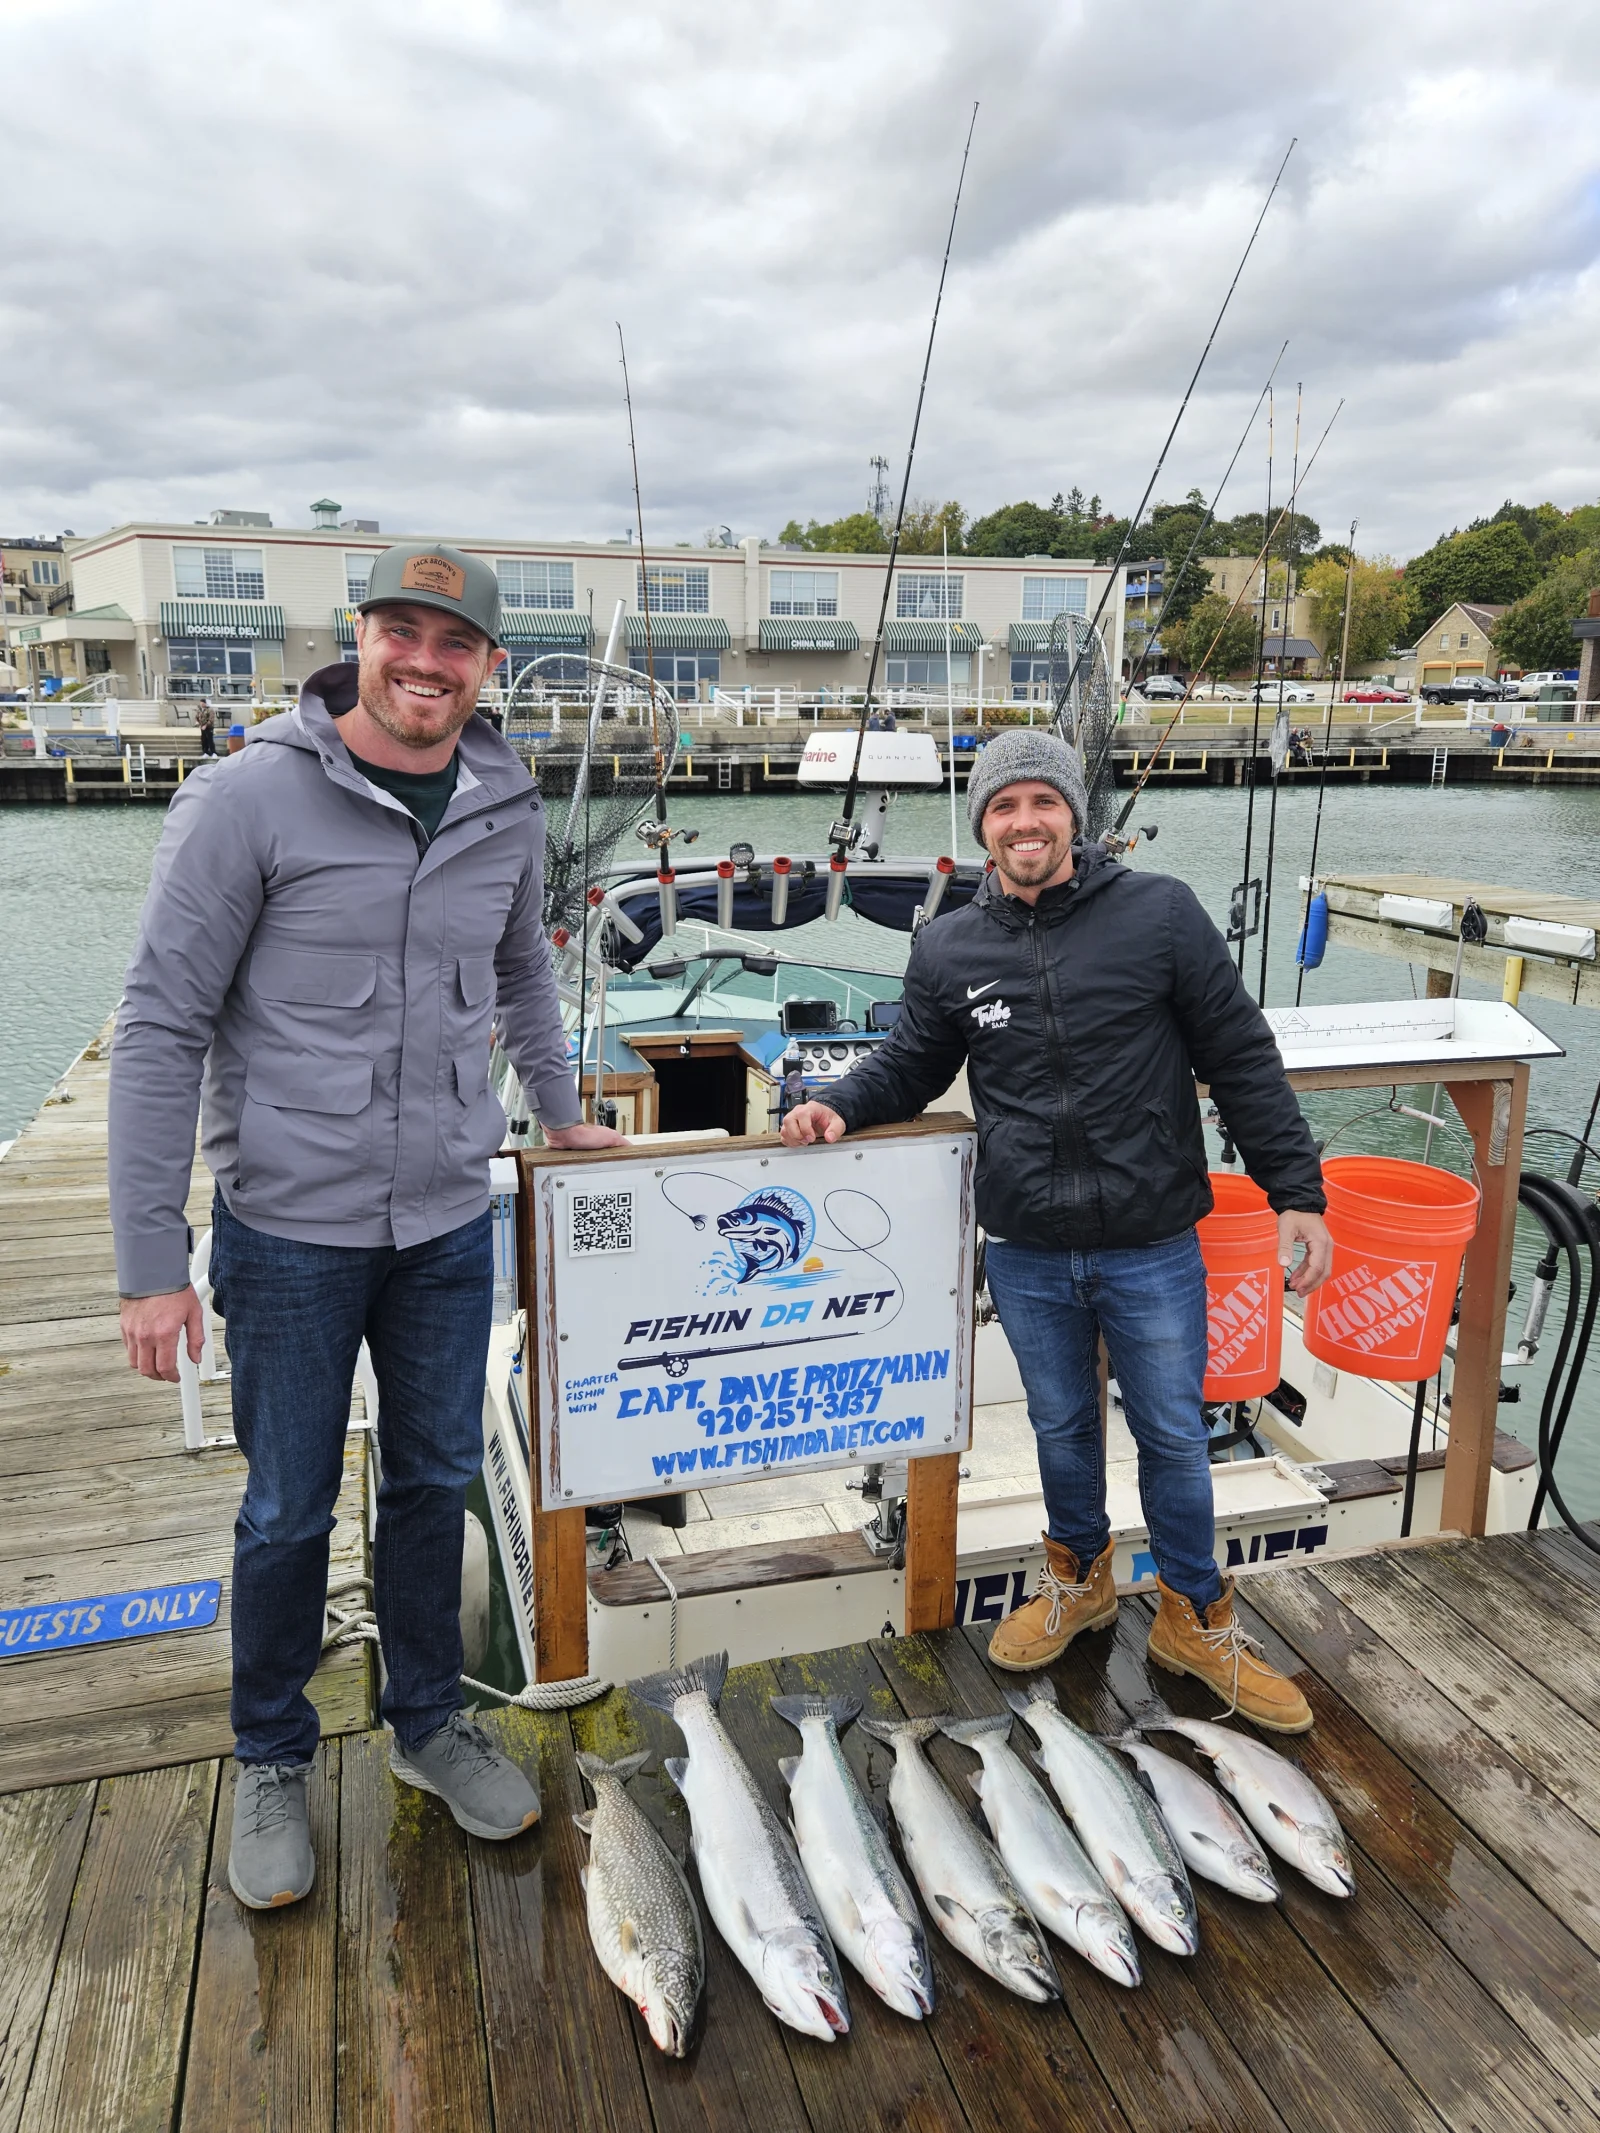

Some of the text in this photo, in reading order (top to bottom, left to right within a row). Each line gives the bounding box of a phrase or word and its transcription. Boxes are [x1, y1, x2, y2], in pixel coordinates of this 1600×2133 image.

[413, 558, 456, 577] JACK BROWN'S
[414, 581, 435, 589] Seaplane
[187, 625, 259, 636] DOCKSIDE DELI
[791, 640, 835, 648] CHINA KING
[971, 999, 1011, 1028] Tribe
[1330, 1264, 1377, 1296] THE
[624, 1290, 896, 1345] FISHIN DA NET
[1207, 1272, 1269, 1351] OME
[1318, 1263, 1433, 1342] HOME
[1207, 1308, 1267, 1376] DEPOT
[1353, 1299, 1426, 1353] DEPOT
[565, 1372, 619, 1391] CHARTER
[566, 1387, 606, 1403] FISHIN
[616, 1349, 951, 1419] CAPT. DAVE PROTZMANN
[568, 1401, 598, 1415] WITH
[696, 1387, 883, 1437] 920-254-3137
[121, 1590, 206, 1628] ONLY
